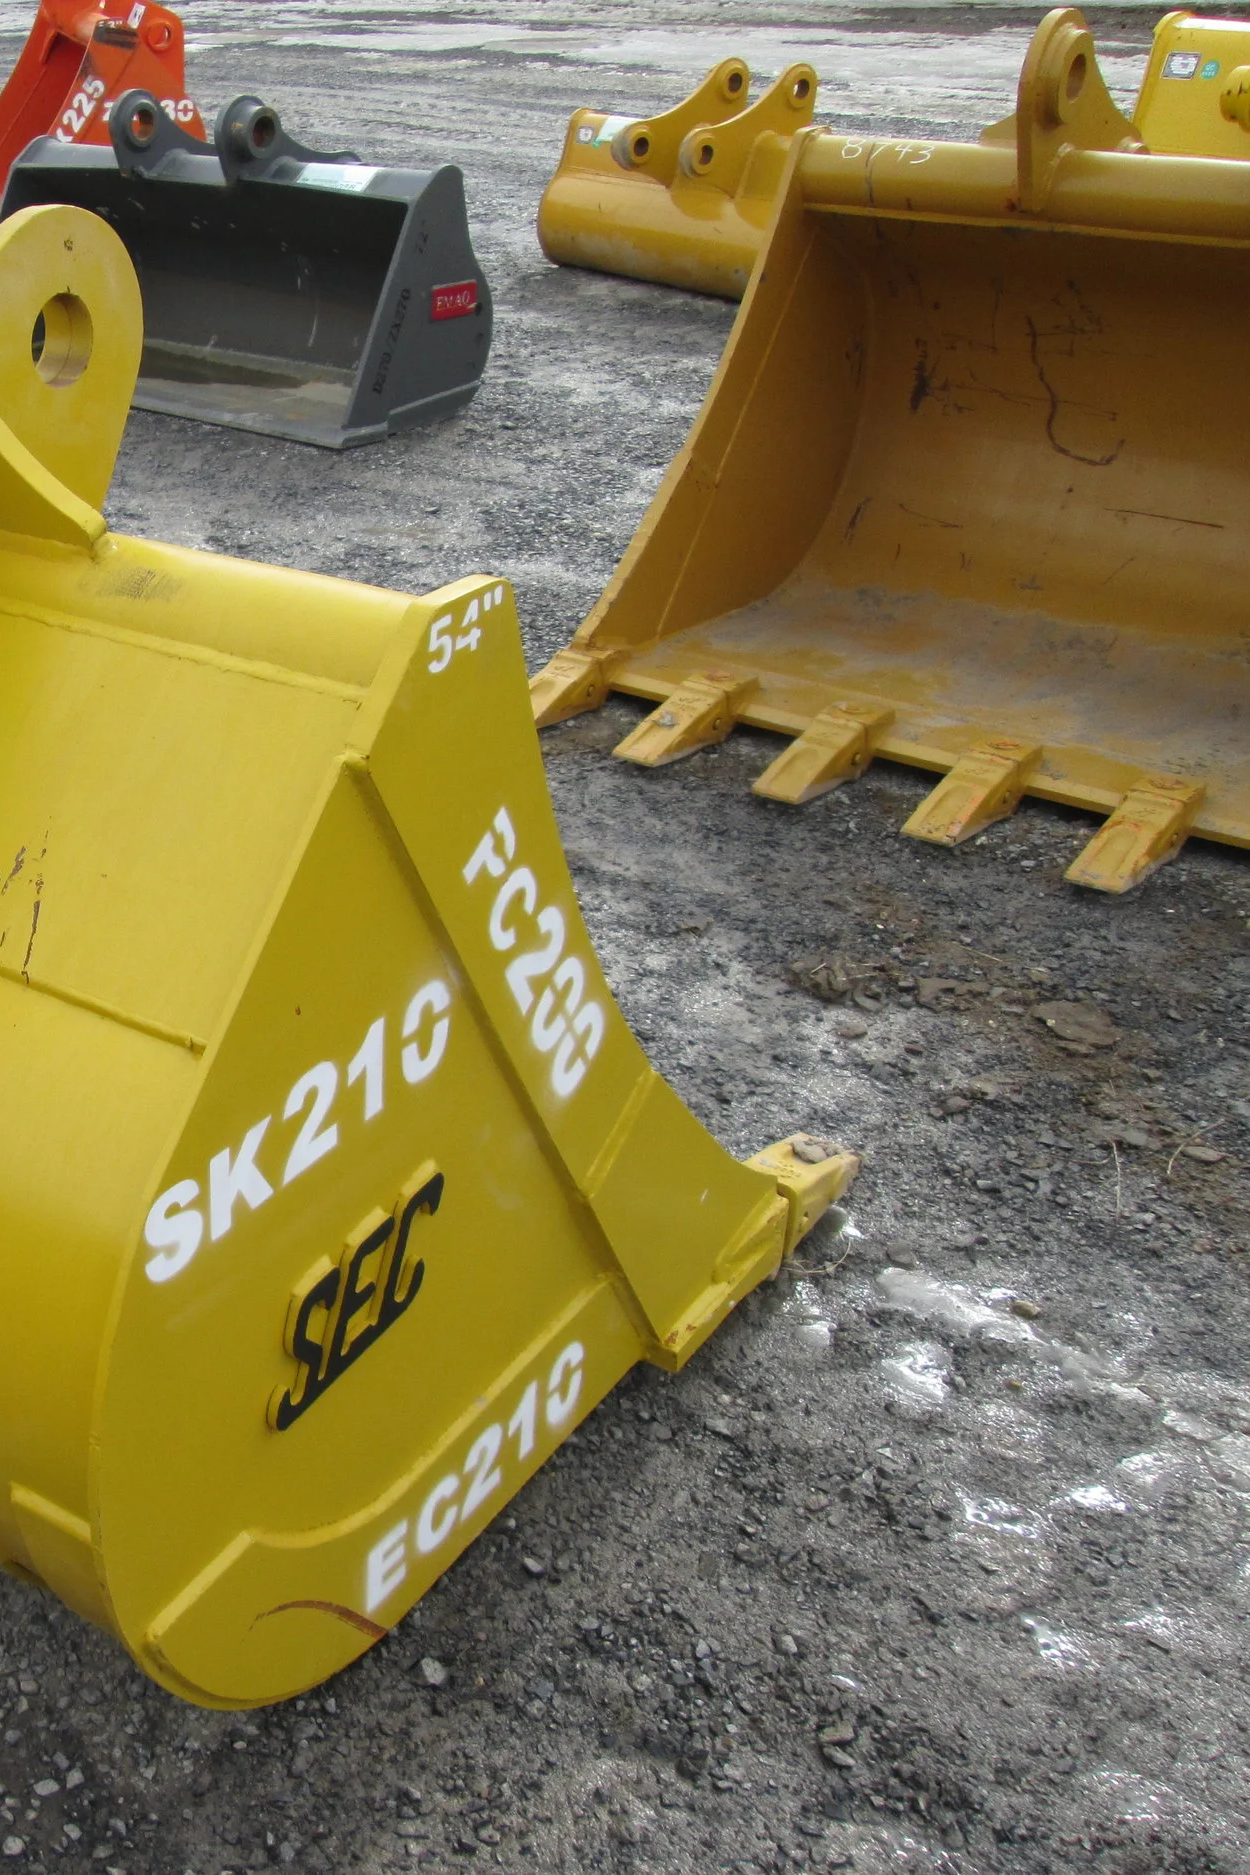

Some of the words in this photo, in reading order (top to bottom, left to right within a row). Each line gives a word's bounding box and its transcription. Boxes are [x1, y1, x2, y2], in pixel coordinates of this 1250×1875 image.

[427, 584, 504, 674] 54"
[461, 804, 606, 1098] PC200
[144, 978, 452, 1284] SK210
[268, 1163, 446, 1432] SEC
[365, 1340, 586, 1615] EC210
